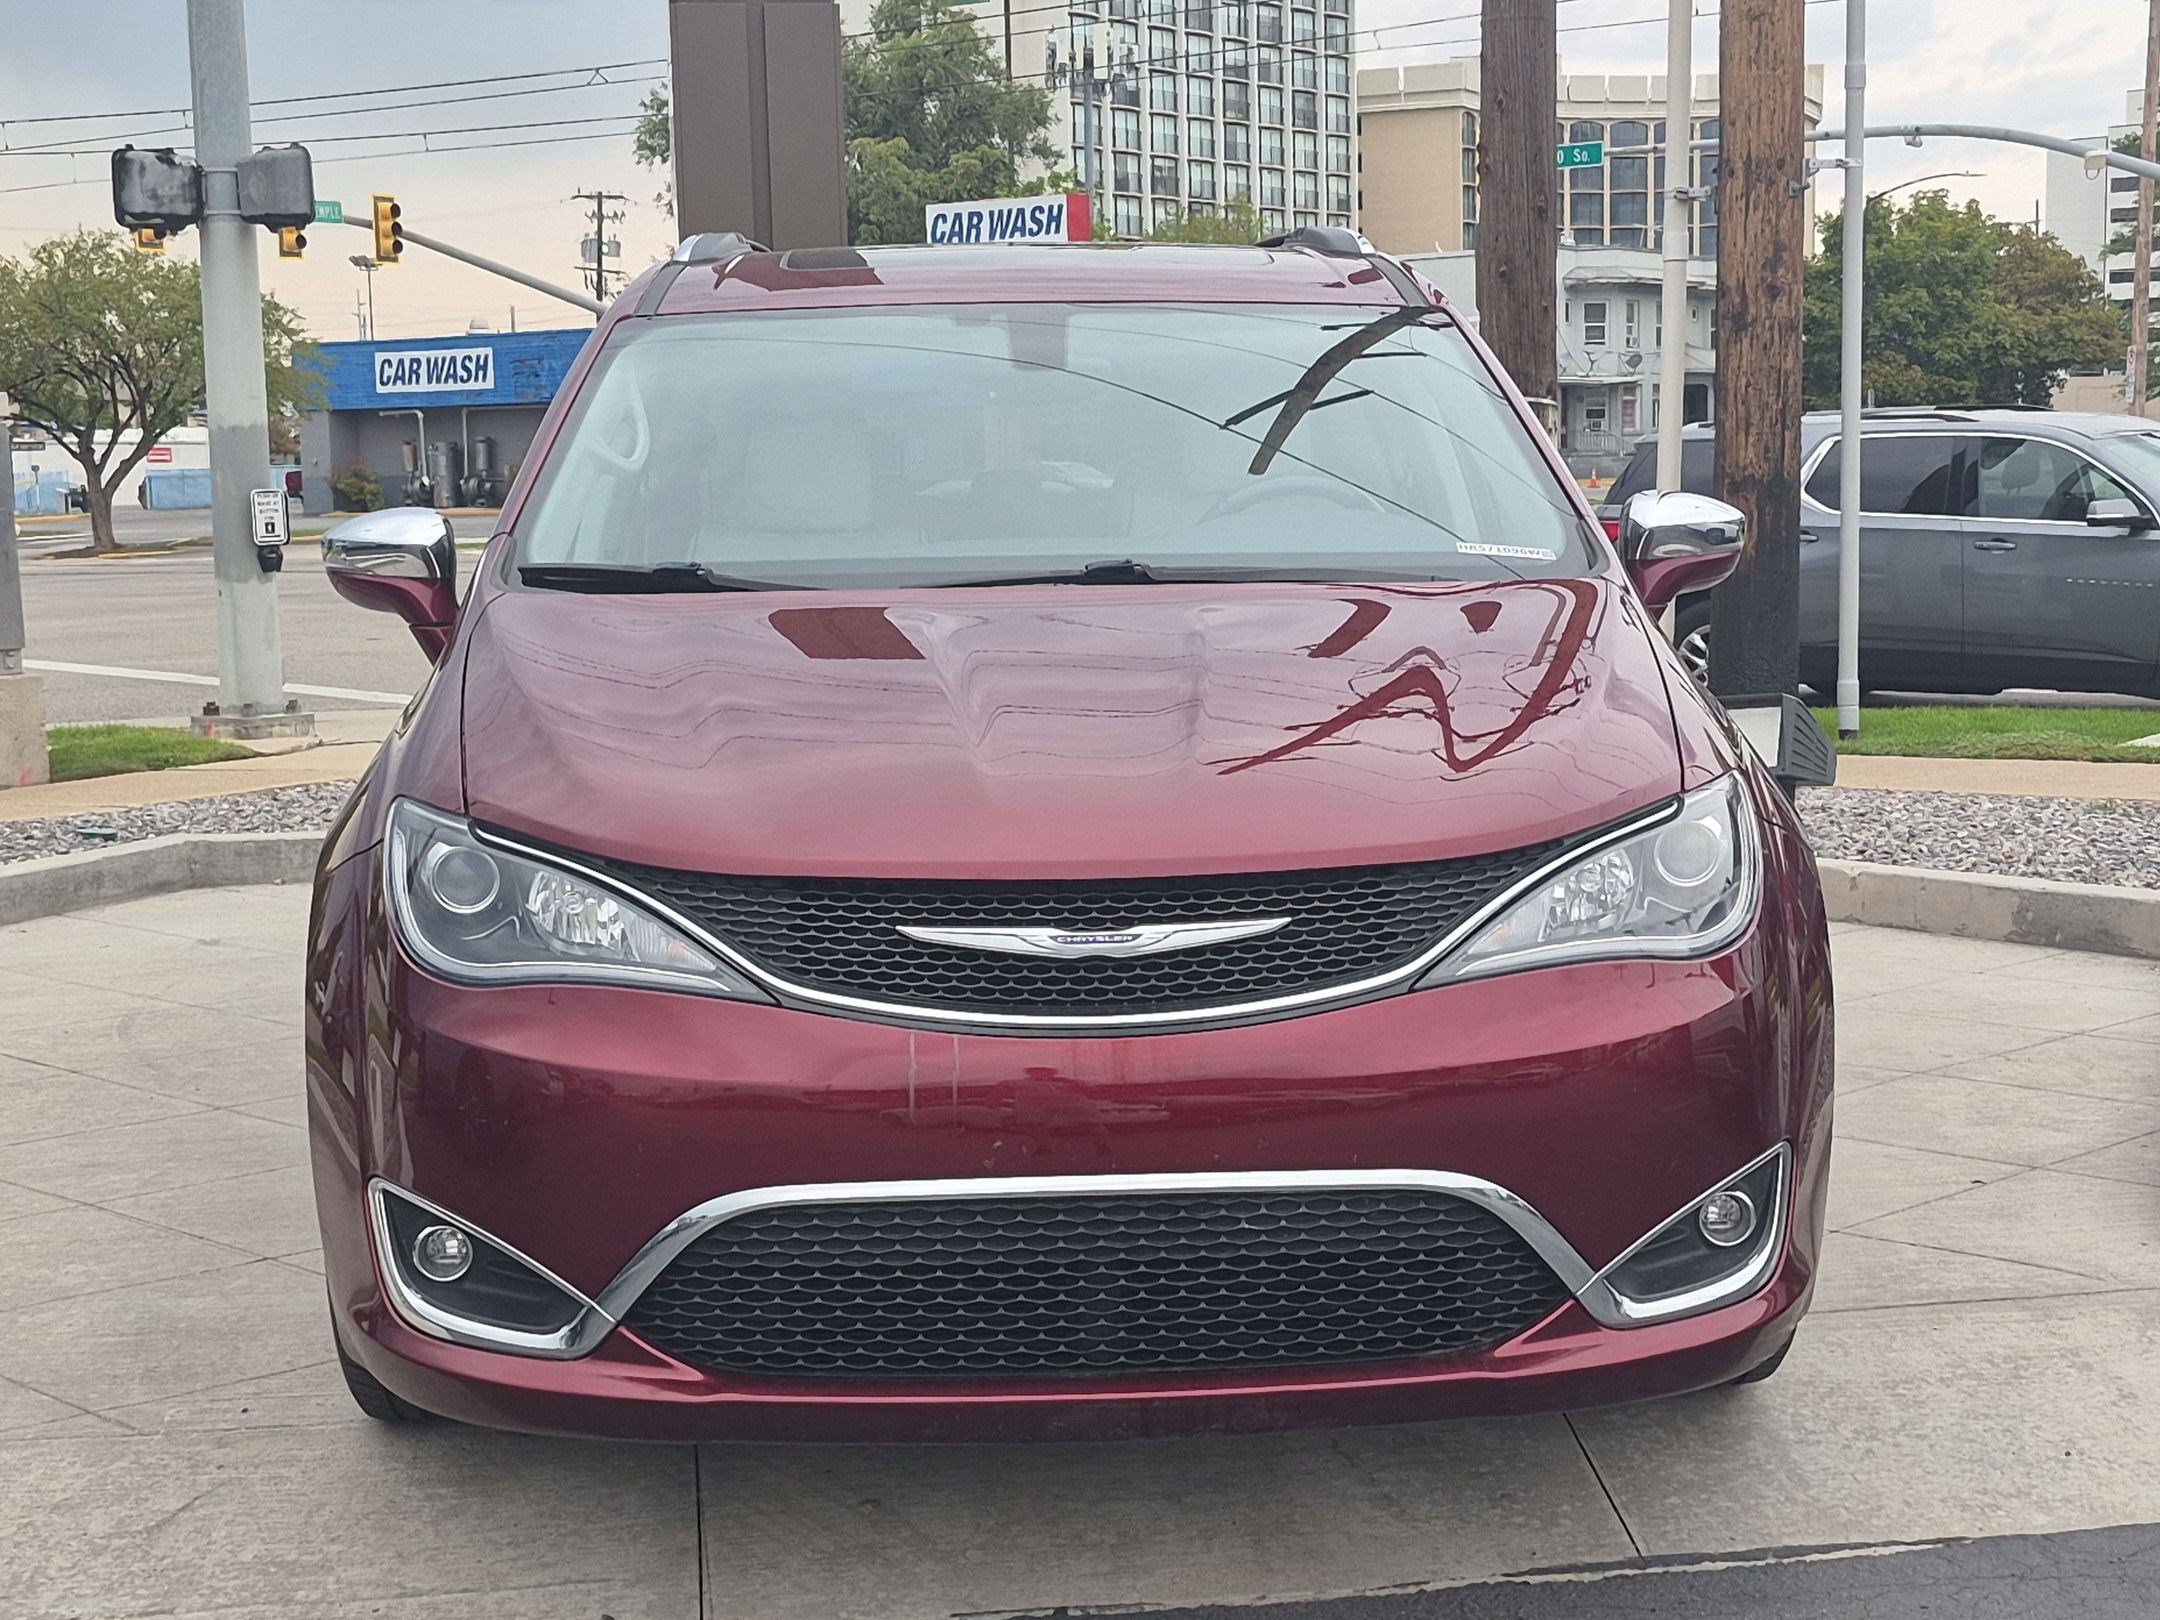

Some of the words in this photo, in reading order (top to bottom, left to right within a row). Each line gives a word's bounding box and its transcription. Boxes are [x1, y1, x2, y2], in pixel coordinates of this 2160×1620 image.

[931, 211, 984, 244] CAR
[988, 203, 1064, 241] WASH
[379, 358, 422, 386] CAR
[426, 353, 489, 384] WASH
[1057, 935, 1133, 943] CHRYSLER
